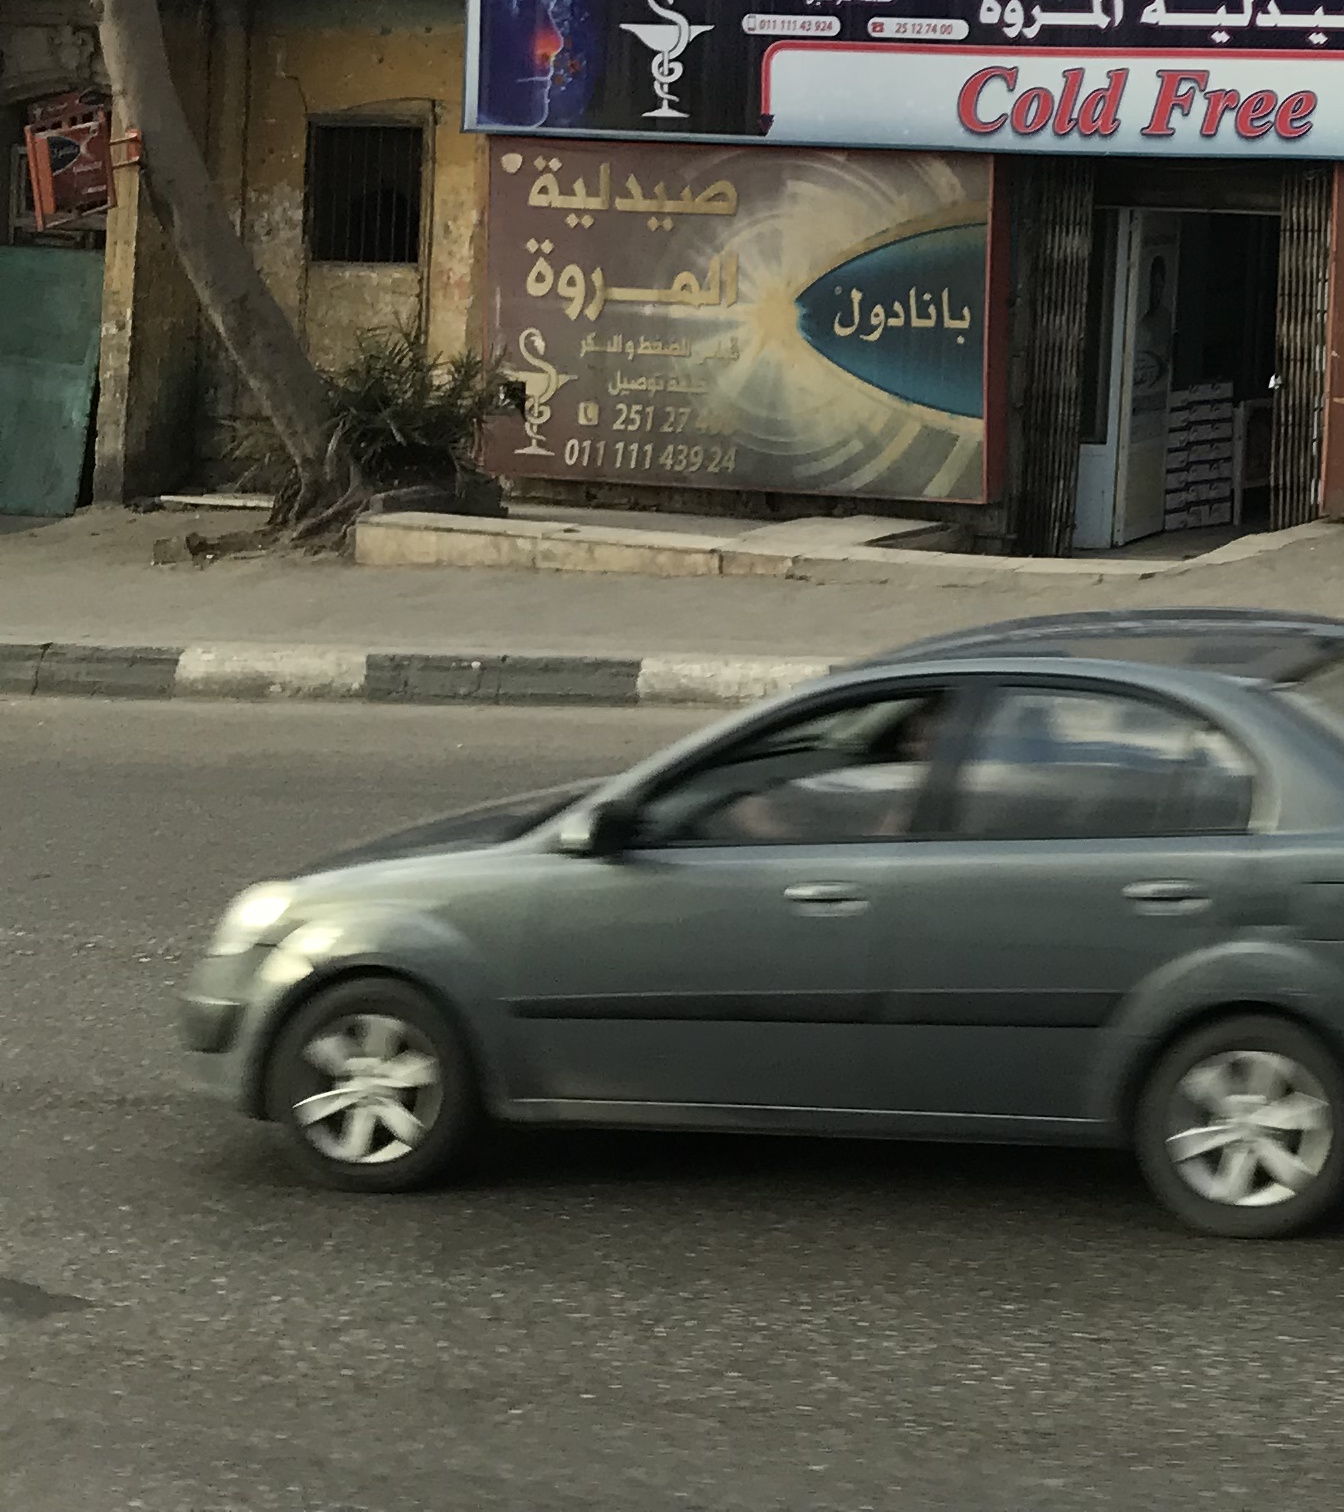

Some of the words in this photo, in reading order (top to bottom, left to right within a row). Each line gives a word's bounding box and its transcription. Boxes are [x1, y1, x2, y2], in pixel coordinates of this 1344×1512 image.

[759, 19, 776, 30] 011
[781, 19, 797, 31] 111
[814, 20, 833, 32] 924
[895, 22, 907, 33] 25
[911, 22, 922, 34] 12
[940, 23, 953, 36] 00
[956, 64, 1130, 138] Cold
[1140, 68, 1318, 140] Free
[528, 156, 738, 232] صيدلية
[525, 238, 739, 321] المروة
[834, 286, 971, 344] بانادول
[612, 403, 655, 432] 251
[662, 406, 693, 434] 27
[564, 438, 606, 466] 011
[614, 440, 654, 469] 111
